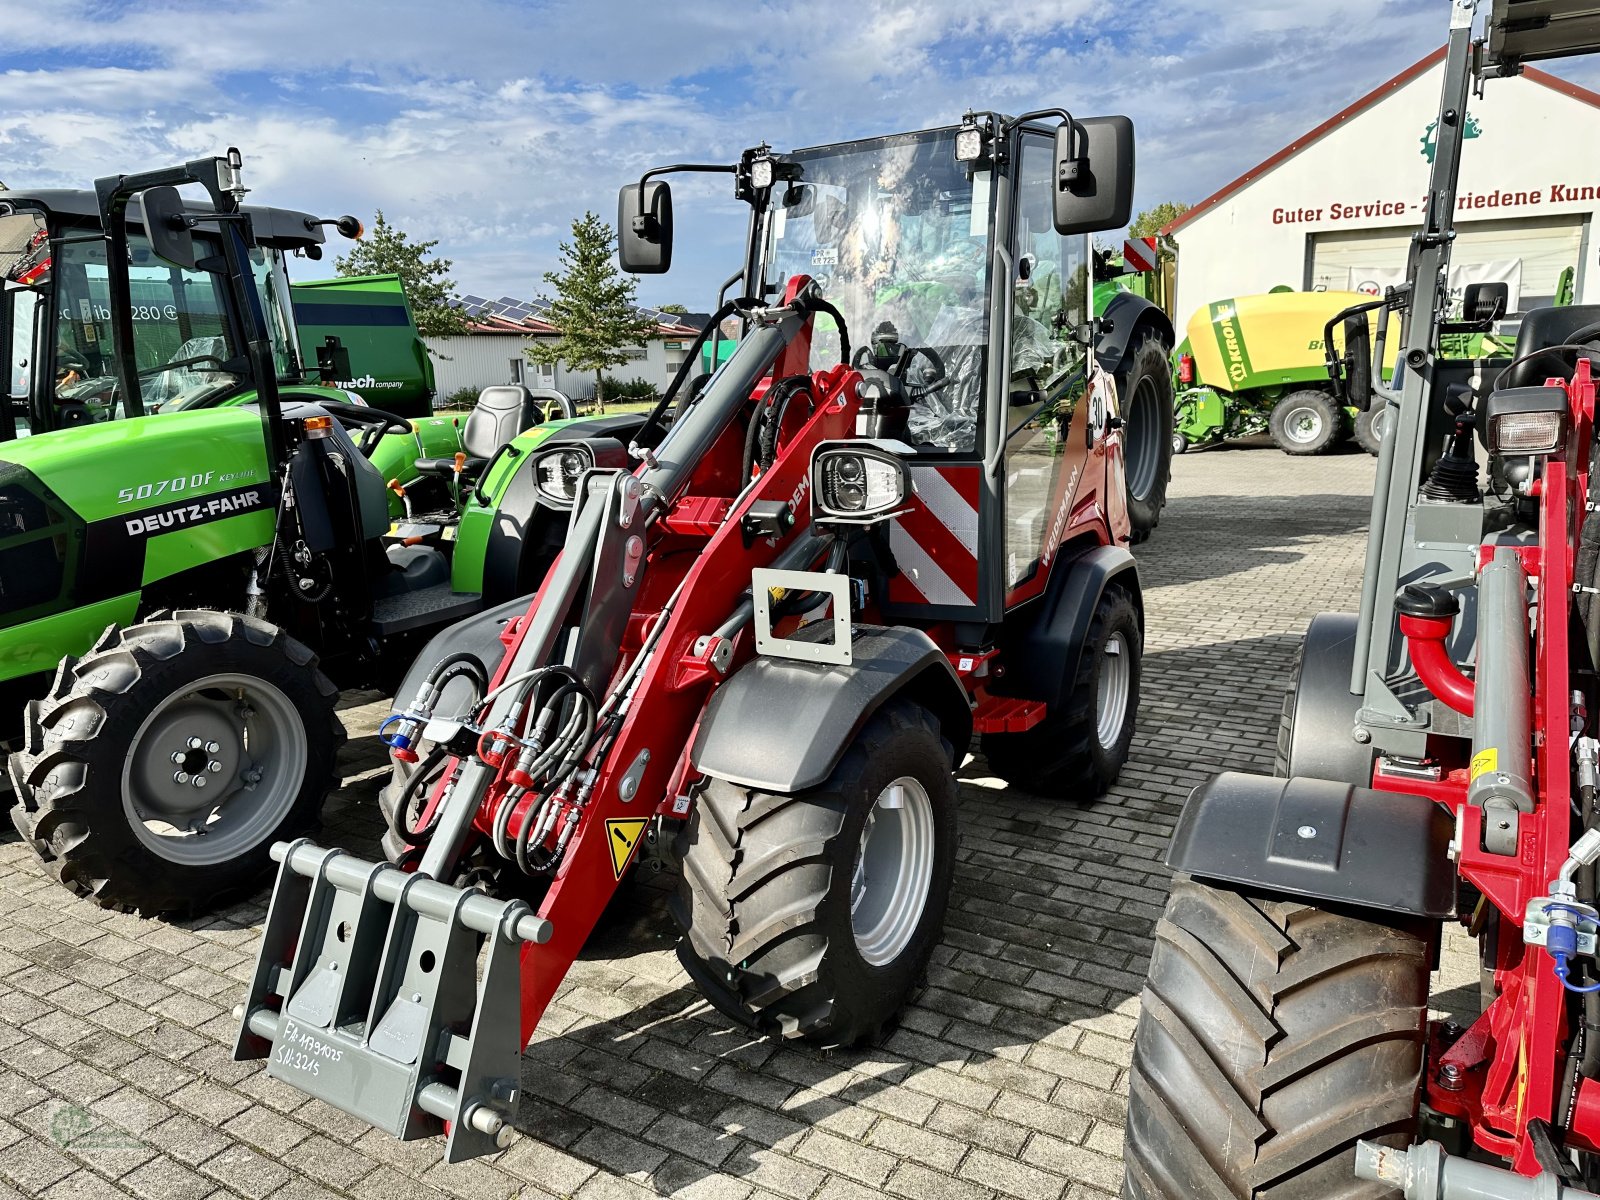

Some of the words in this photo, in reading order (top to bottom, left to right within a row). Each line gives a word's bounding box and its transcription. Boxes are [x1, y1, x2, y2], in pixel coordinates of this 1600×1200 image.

[1272, 208, 1323, 225] Guter
[1329, 200, 1405, 220] Service
[1549, 184, 1600, 203] Kun
[375, 380, 404, 389] company
[1092, 396, 1103, 431] 30
[117, 477, 187, 505] 5070
[125, 490, 261, 536] DEUTZ-FAHR
[1041, 464, 1078, 568] WEIDEMANN
